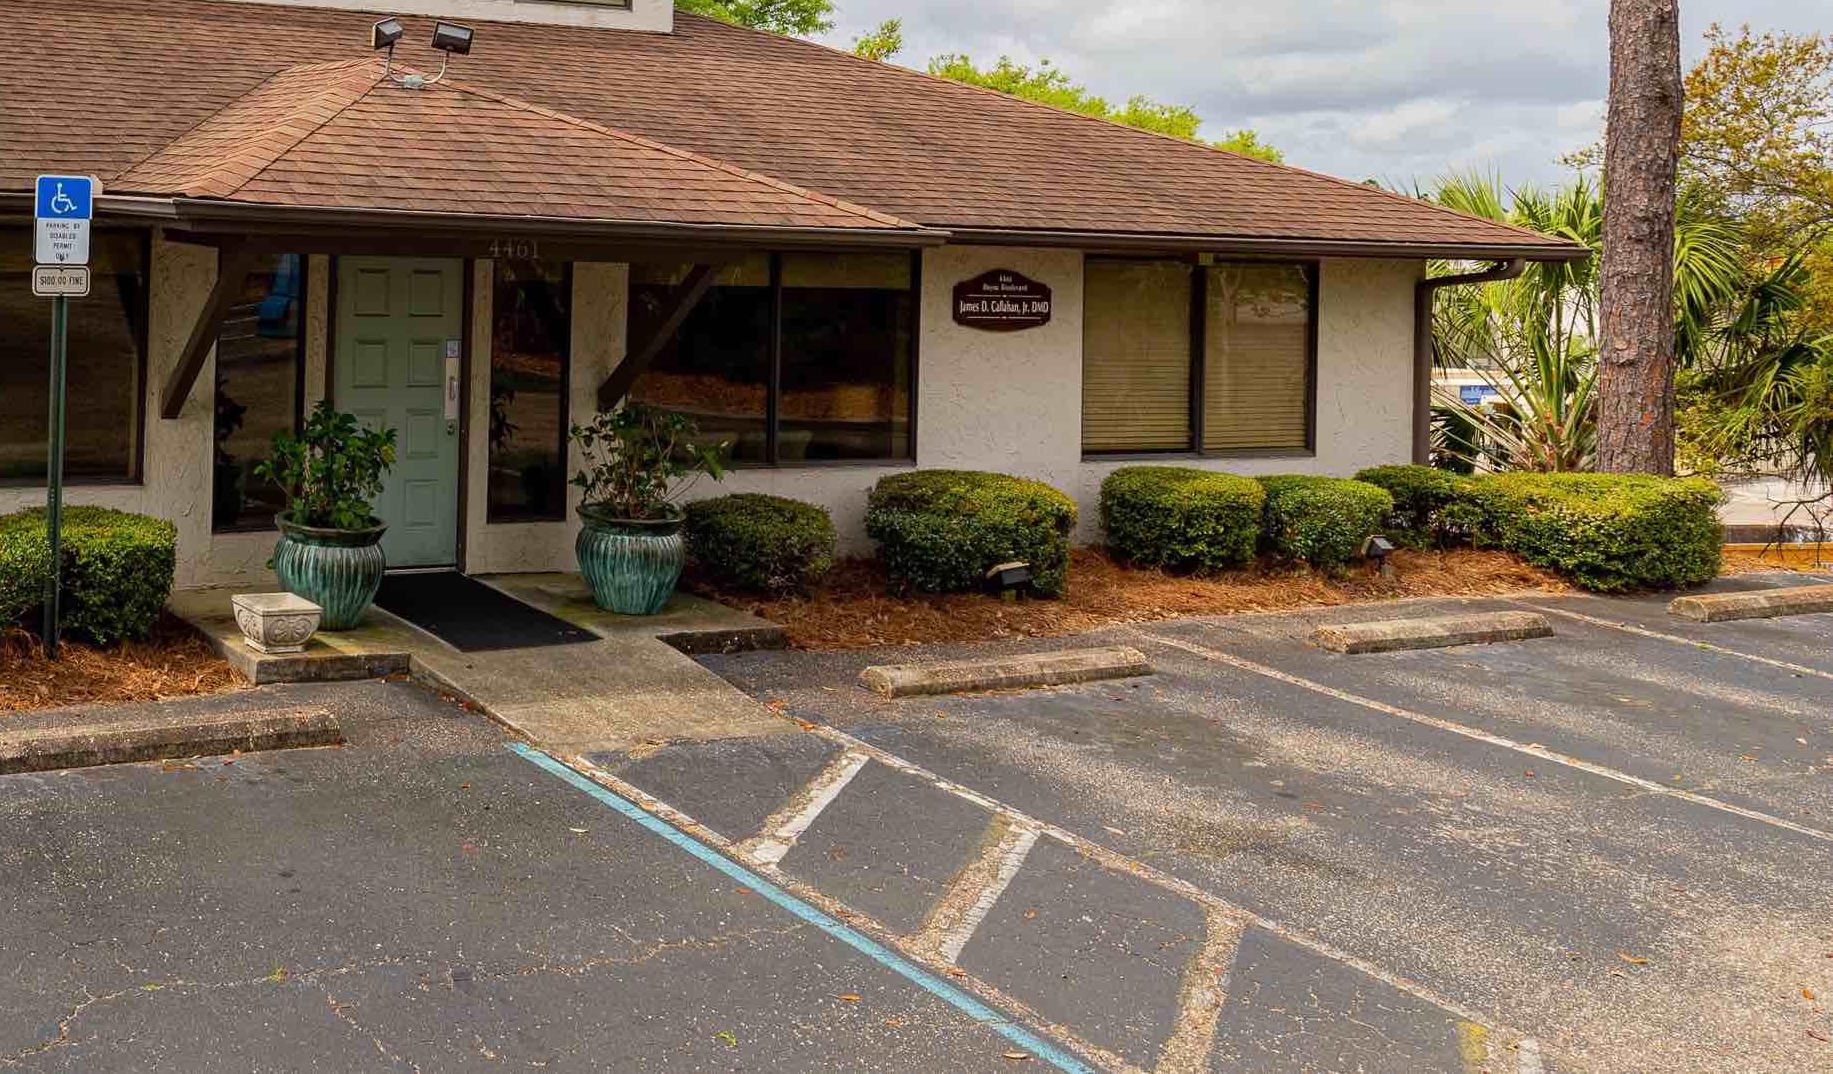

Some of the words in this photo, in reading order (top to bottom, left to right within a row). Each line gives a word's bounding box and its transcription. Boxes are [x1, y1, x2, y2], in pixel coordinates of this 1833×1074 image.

[54, 242, 72, 250] PERMIT
[69, 276, 84, 286] FINE
[959, 300, 980, 314] James
[981, 301, 989, 312] D.
[991, 300, 1021, 313] Callahan,
[1022, 301, 1030, 315] Jr.
[1031, 301, 1049, 313] DMD
